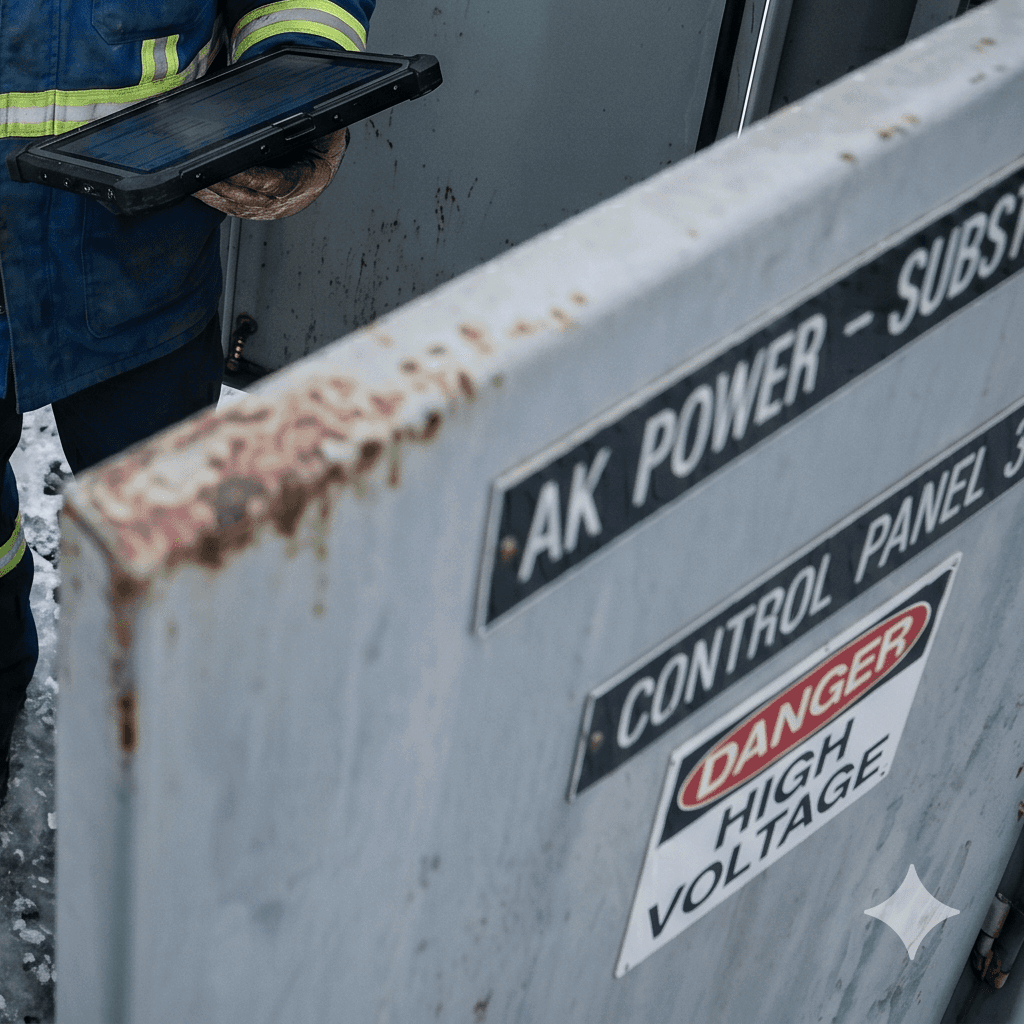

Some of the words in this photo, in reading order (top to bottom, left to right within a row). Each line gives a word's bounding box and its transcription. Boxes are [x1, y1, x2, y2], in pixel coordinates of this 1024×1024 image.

[518, 446, 611, 582] AK
[632, 313, 827, 507] POWER
[616, 552, 833, 749] CONTROL
[853, 445, 988, 584] PANEL
[695, 614, 914, 801] DANGER
[715, 716, 856, 851] HIGH
[648, 732, 890, 940] VOLTAGE
